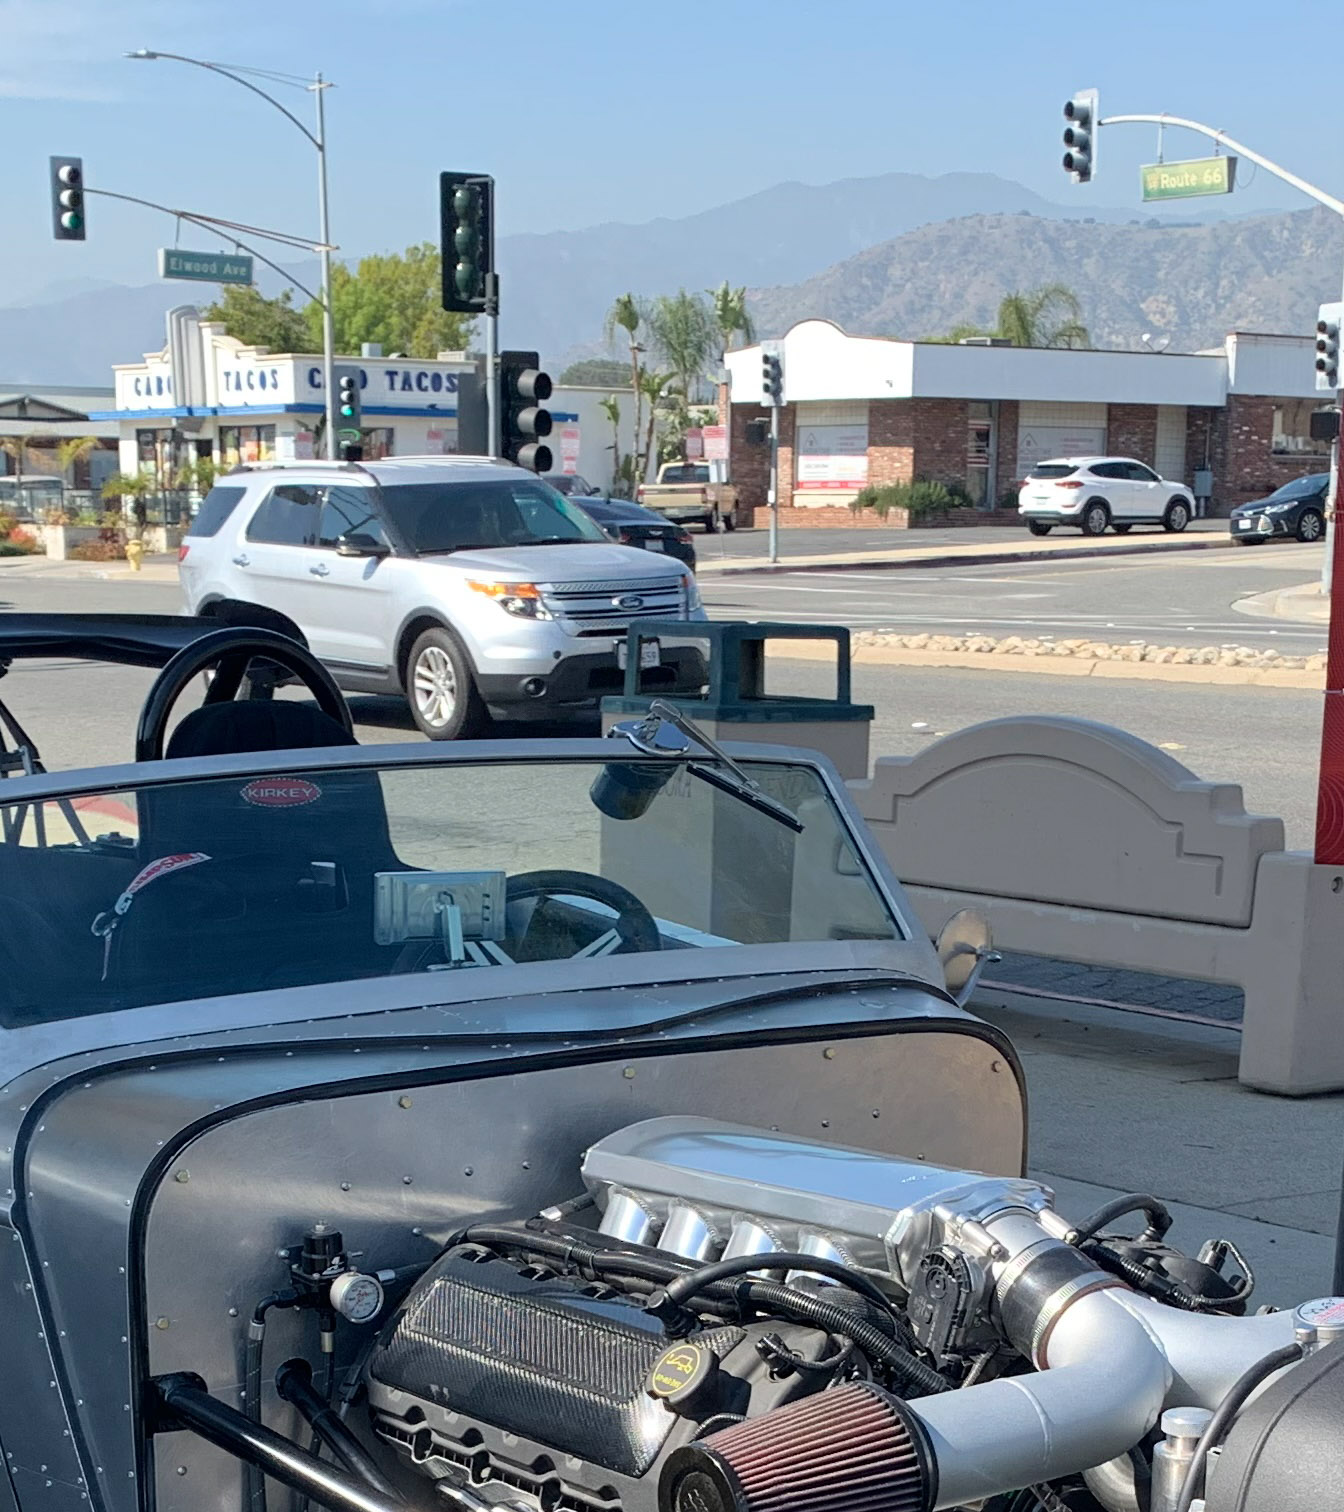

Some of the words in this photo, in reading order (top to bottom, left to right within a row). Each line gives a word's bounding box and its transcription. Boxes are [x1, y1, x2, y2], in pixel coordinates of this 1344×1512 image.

[1160, 172, 1198, 188] Route
[1203, 167, 1223, 184] 66
[169, 257, 217, 273] Elwood
[223, 263, 247, 275] Ave
[224, 368, 278, 391] TACOS
[385, 369, 459, 394] TACOS
[248, 788, 313, 797] KIRKEY
